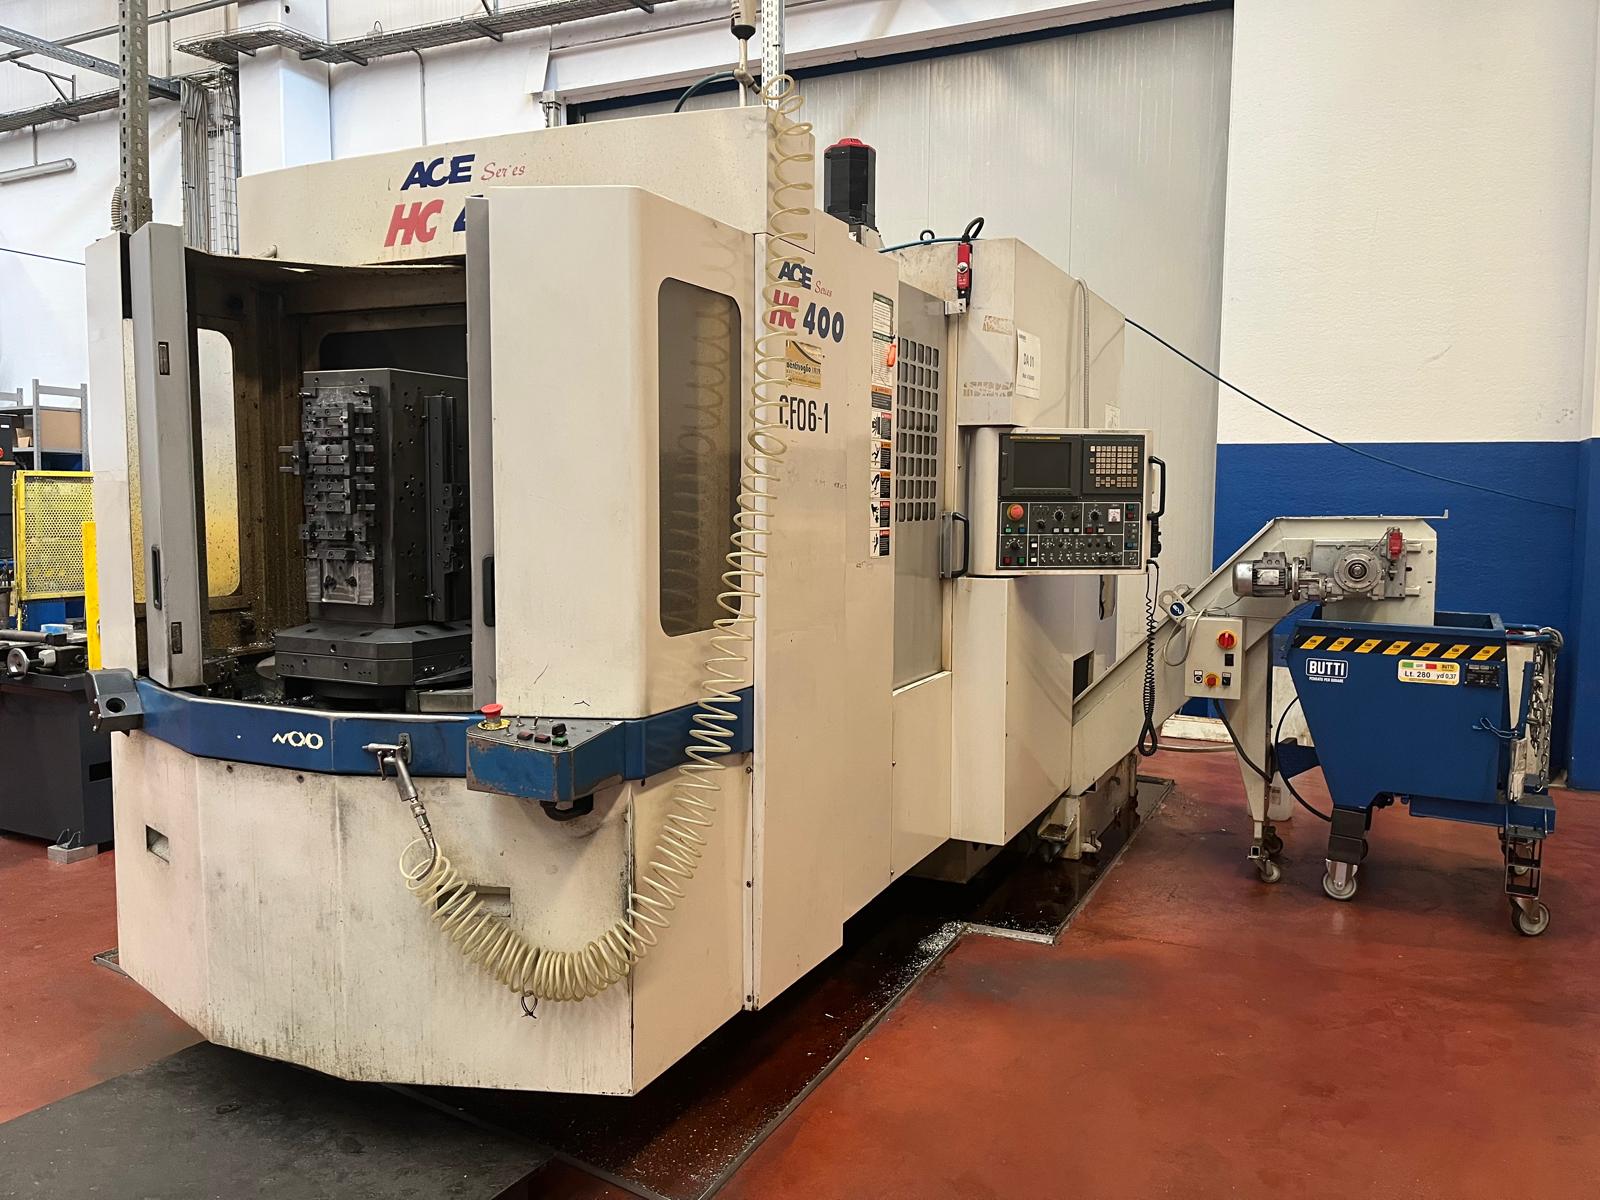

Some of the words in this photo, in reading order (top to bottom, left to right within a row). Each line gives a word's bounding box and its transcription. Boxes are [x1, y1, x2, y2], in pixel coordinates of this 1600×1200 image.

[400, 153, 475, 191] ACE
[777, 261, 813, 290] ACE
[802, 301, 845, 343] 400
[1309, 660, 1345, 676] BUTTI
